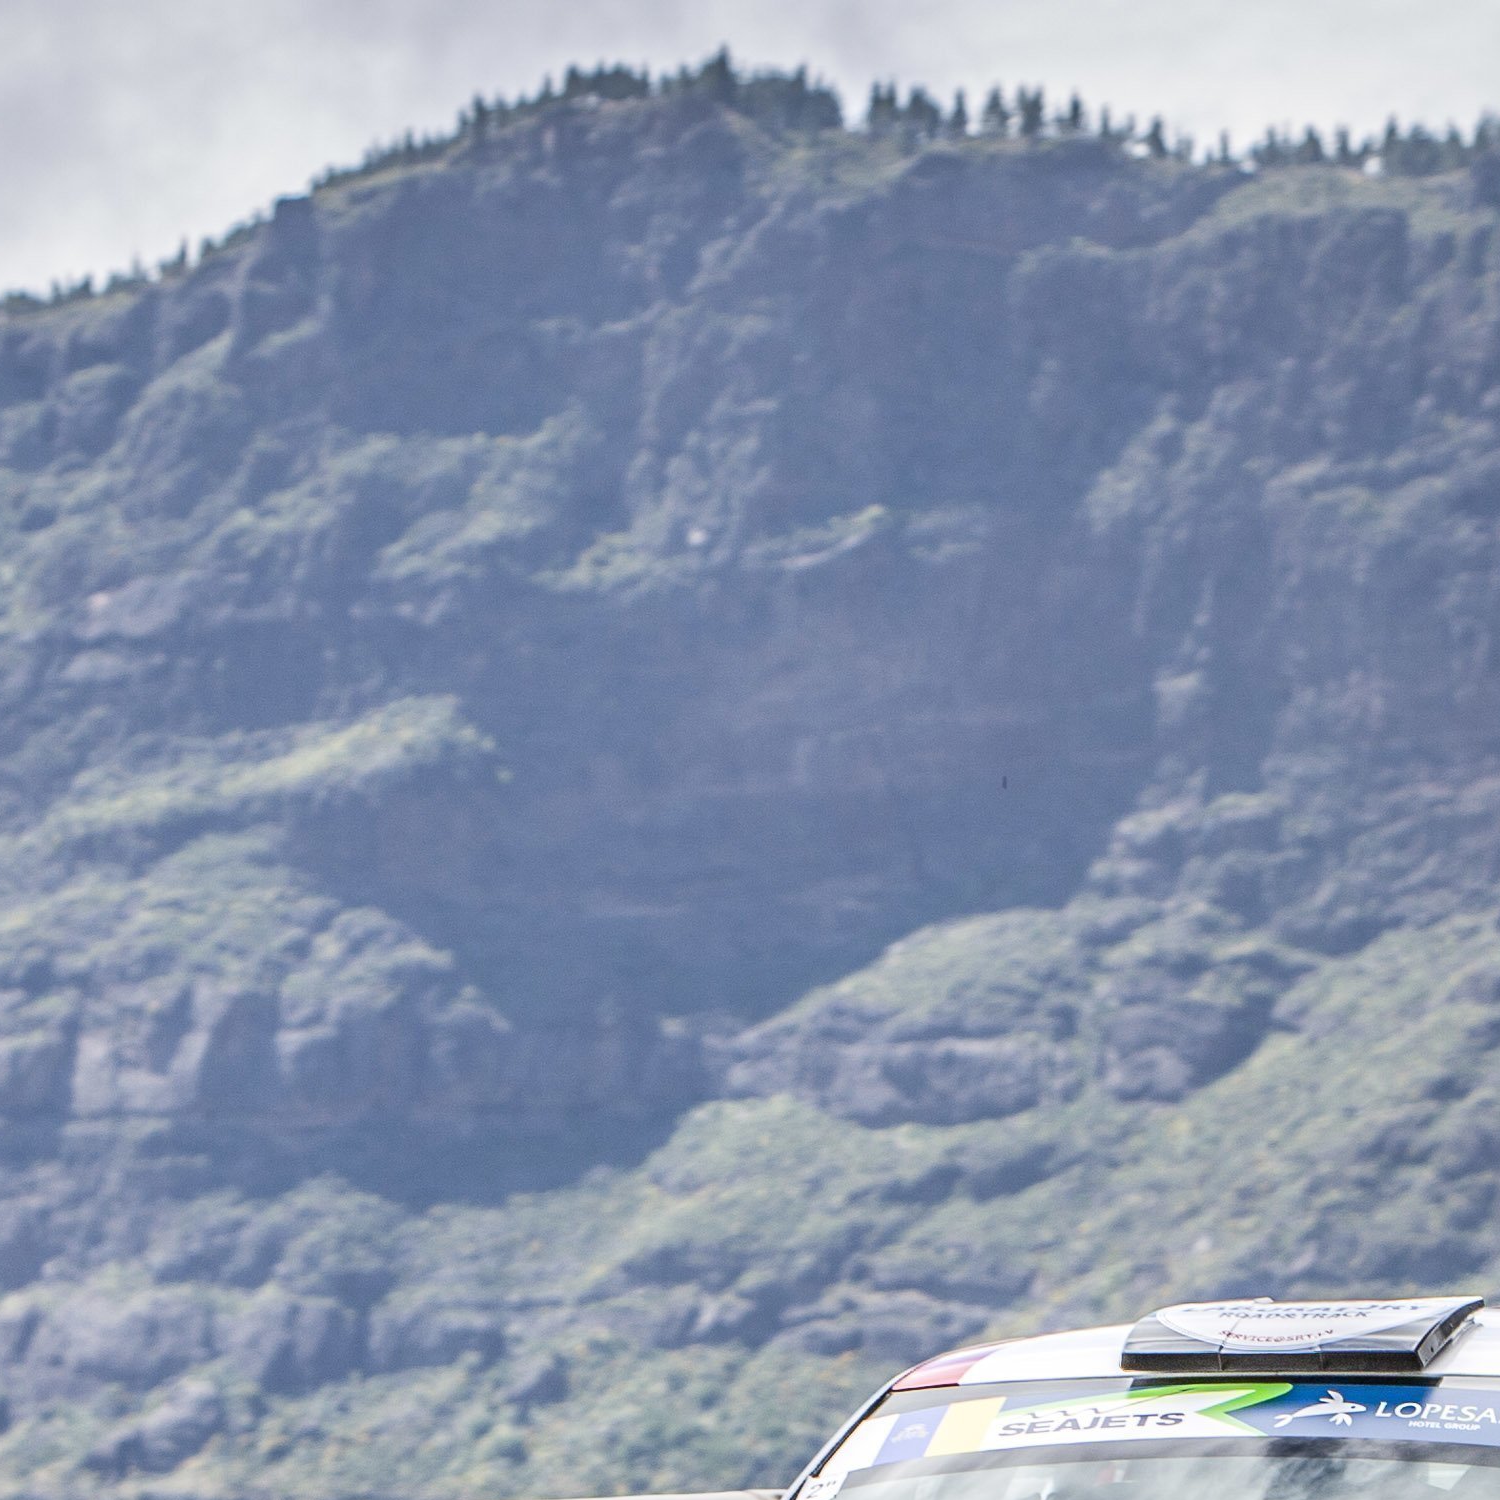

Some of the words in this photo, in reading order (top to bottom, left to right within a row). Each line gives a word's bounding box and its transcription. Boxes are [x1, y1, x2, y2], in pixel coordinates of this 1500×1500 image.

[998, 1412, 1186, 1437] SEAJETS
[1408, 1420, 1442, 1430] HOTEL
[1444, 1421, 1481, 1431] GROUP
